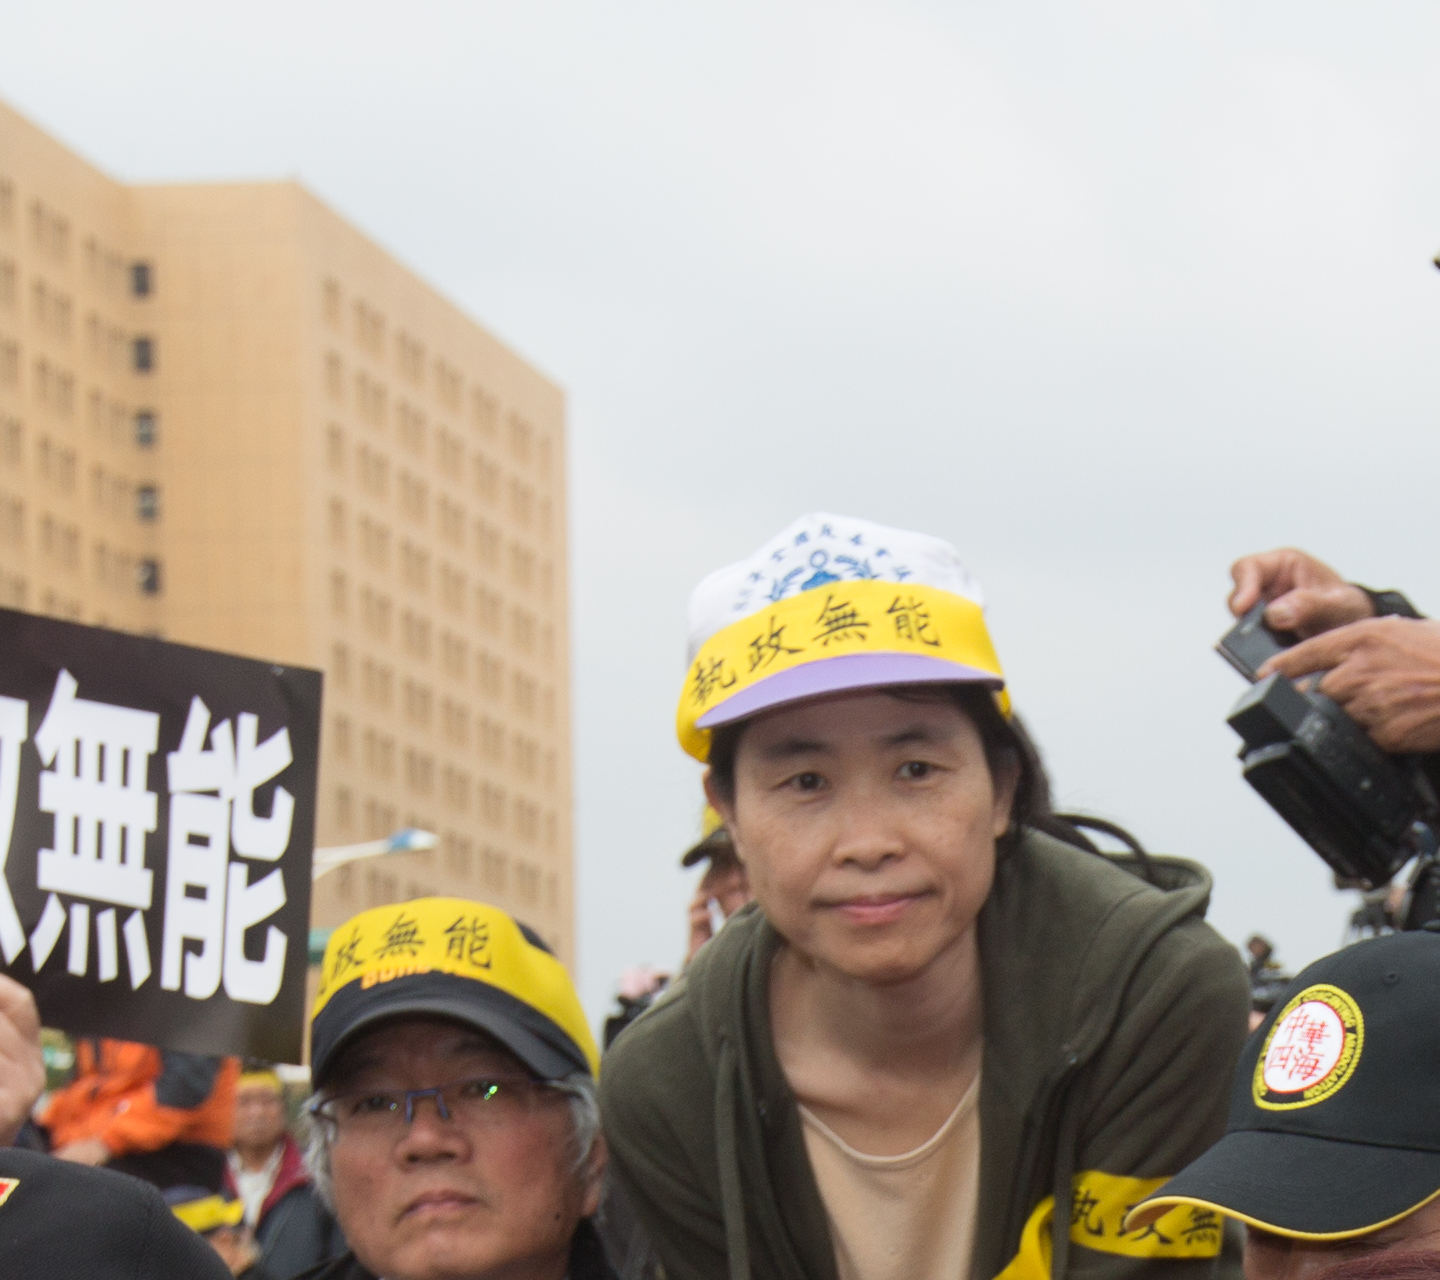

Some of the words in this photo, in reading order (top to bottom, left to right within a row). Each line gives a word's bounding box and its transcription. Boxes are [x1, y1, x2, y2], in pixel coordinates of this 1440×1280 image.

[691, 594, 943, 707] 執政無能
[1284, 1008, 1332, 1057] 中華
[1266, 1046, 1324, 1082] 四海
